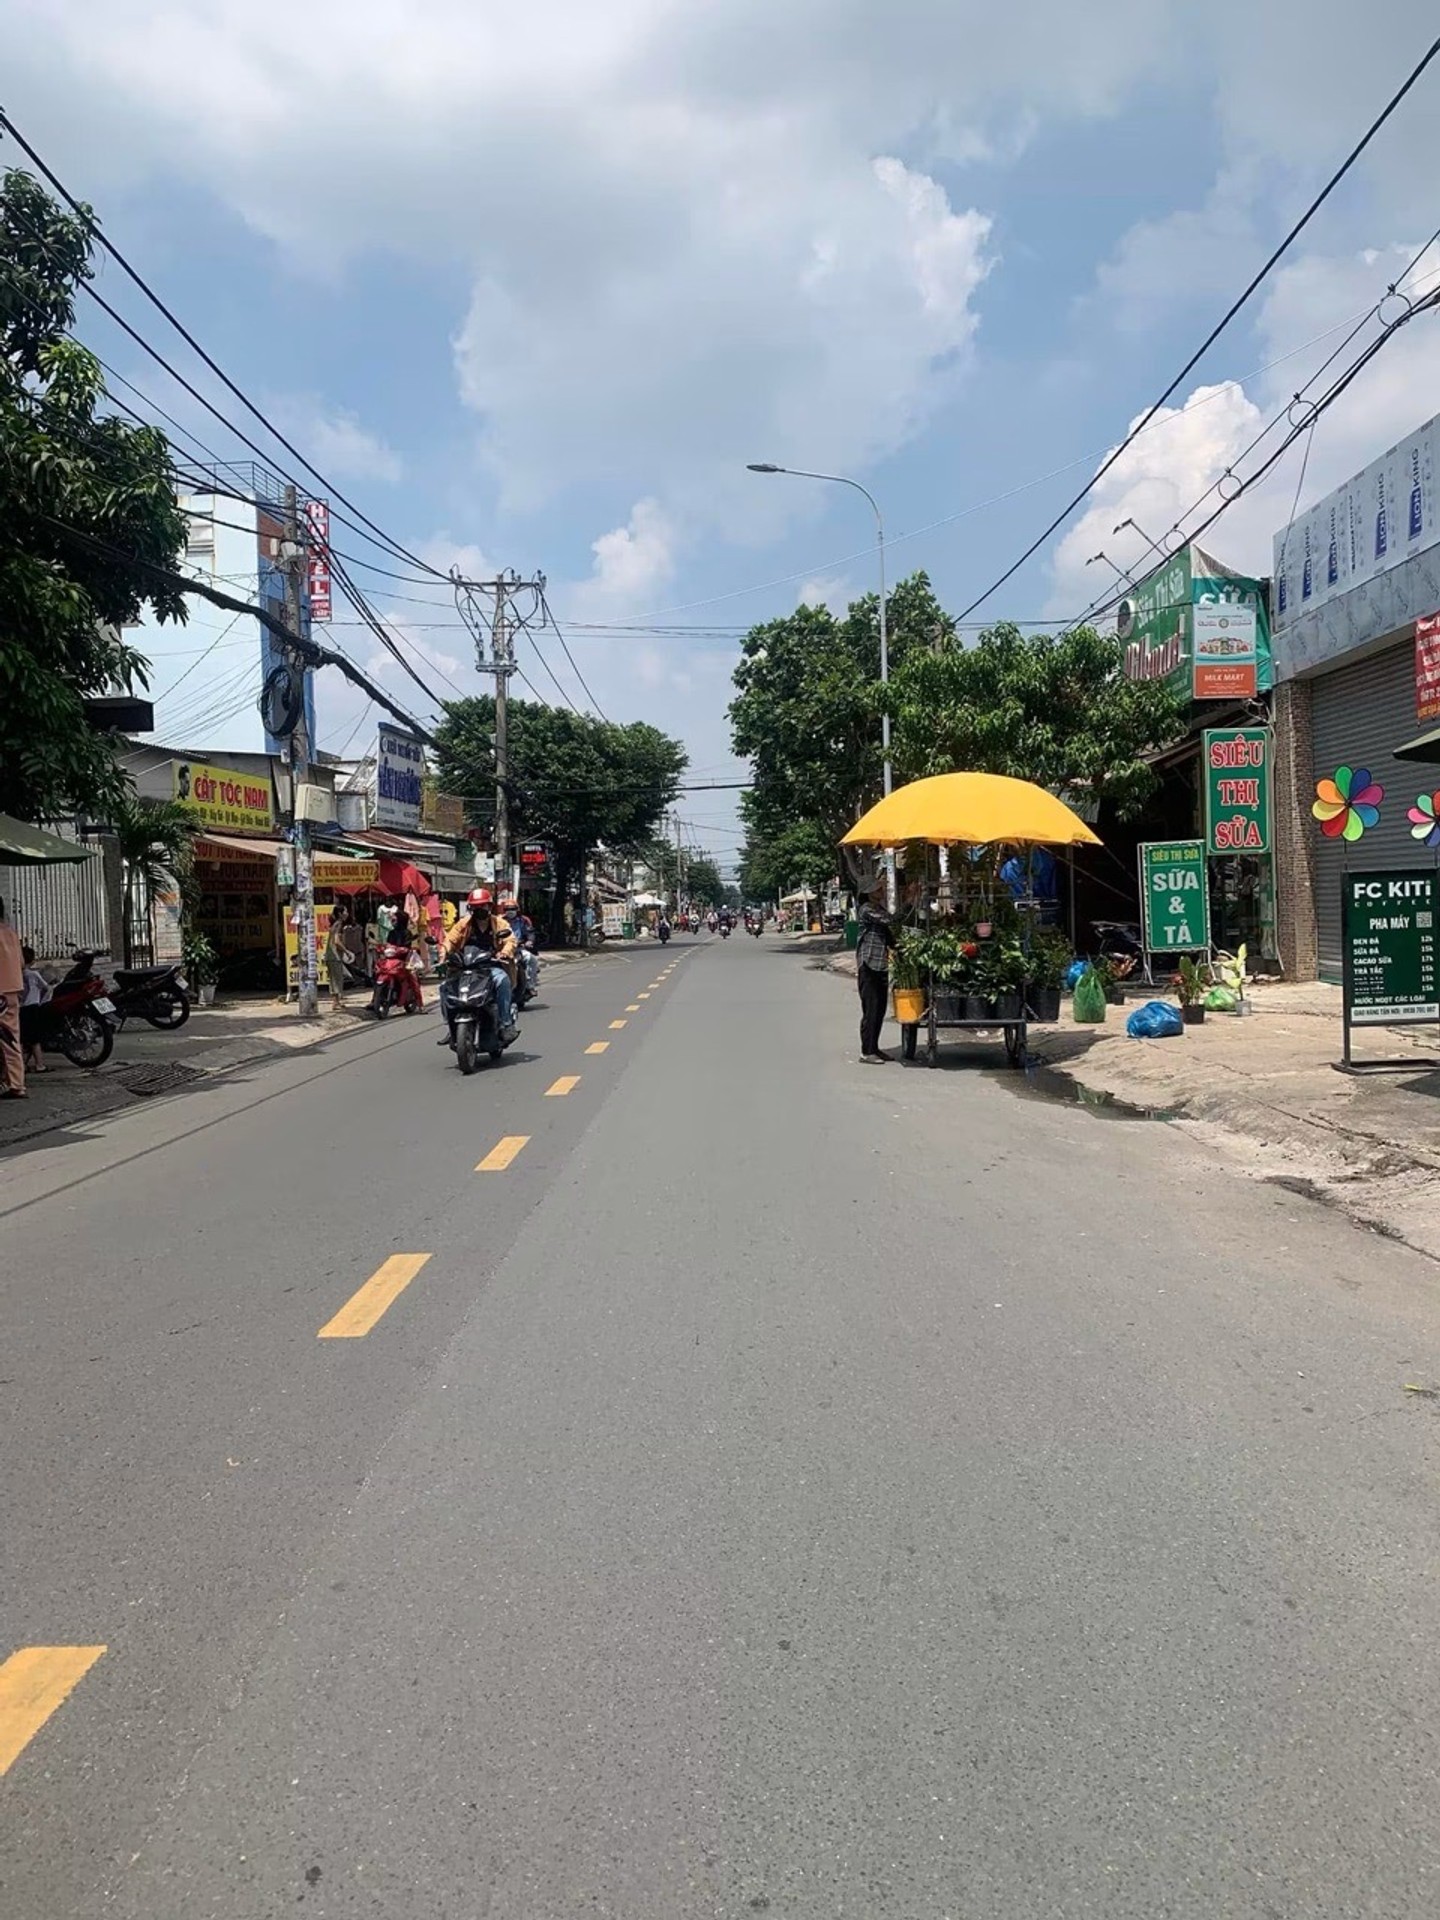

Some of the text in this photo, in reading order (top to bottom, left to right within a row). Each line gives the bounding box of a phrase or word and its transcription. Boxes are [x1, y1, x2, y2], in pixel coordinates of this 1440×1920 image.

[1412, 448, 1420, 487] KING
[1210, 733, 1264, 769] SIÊU
[219, 778, 242, 808] TÓC
[244, 785, 269, 812] NAM
[1216, 779, 1260, 812] THỊ
[1215, 814, 1264, 849] SỮA
[1152, 868, 1200, 892] SỮA
[1353, 882, 1382, 899] FC
[1168, 896, 1186, 915] &
[1163, 918, 1193, 945] TẢ
[1369, 913, 1410, 930] PHA MÁY
[1353, 957, 1377, 966] CACAO
